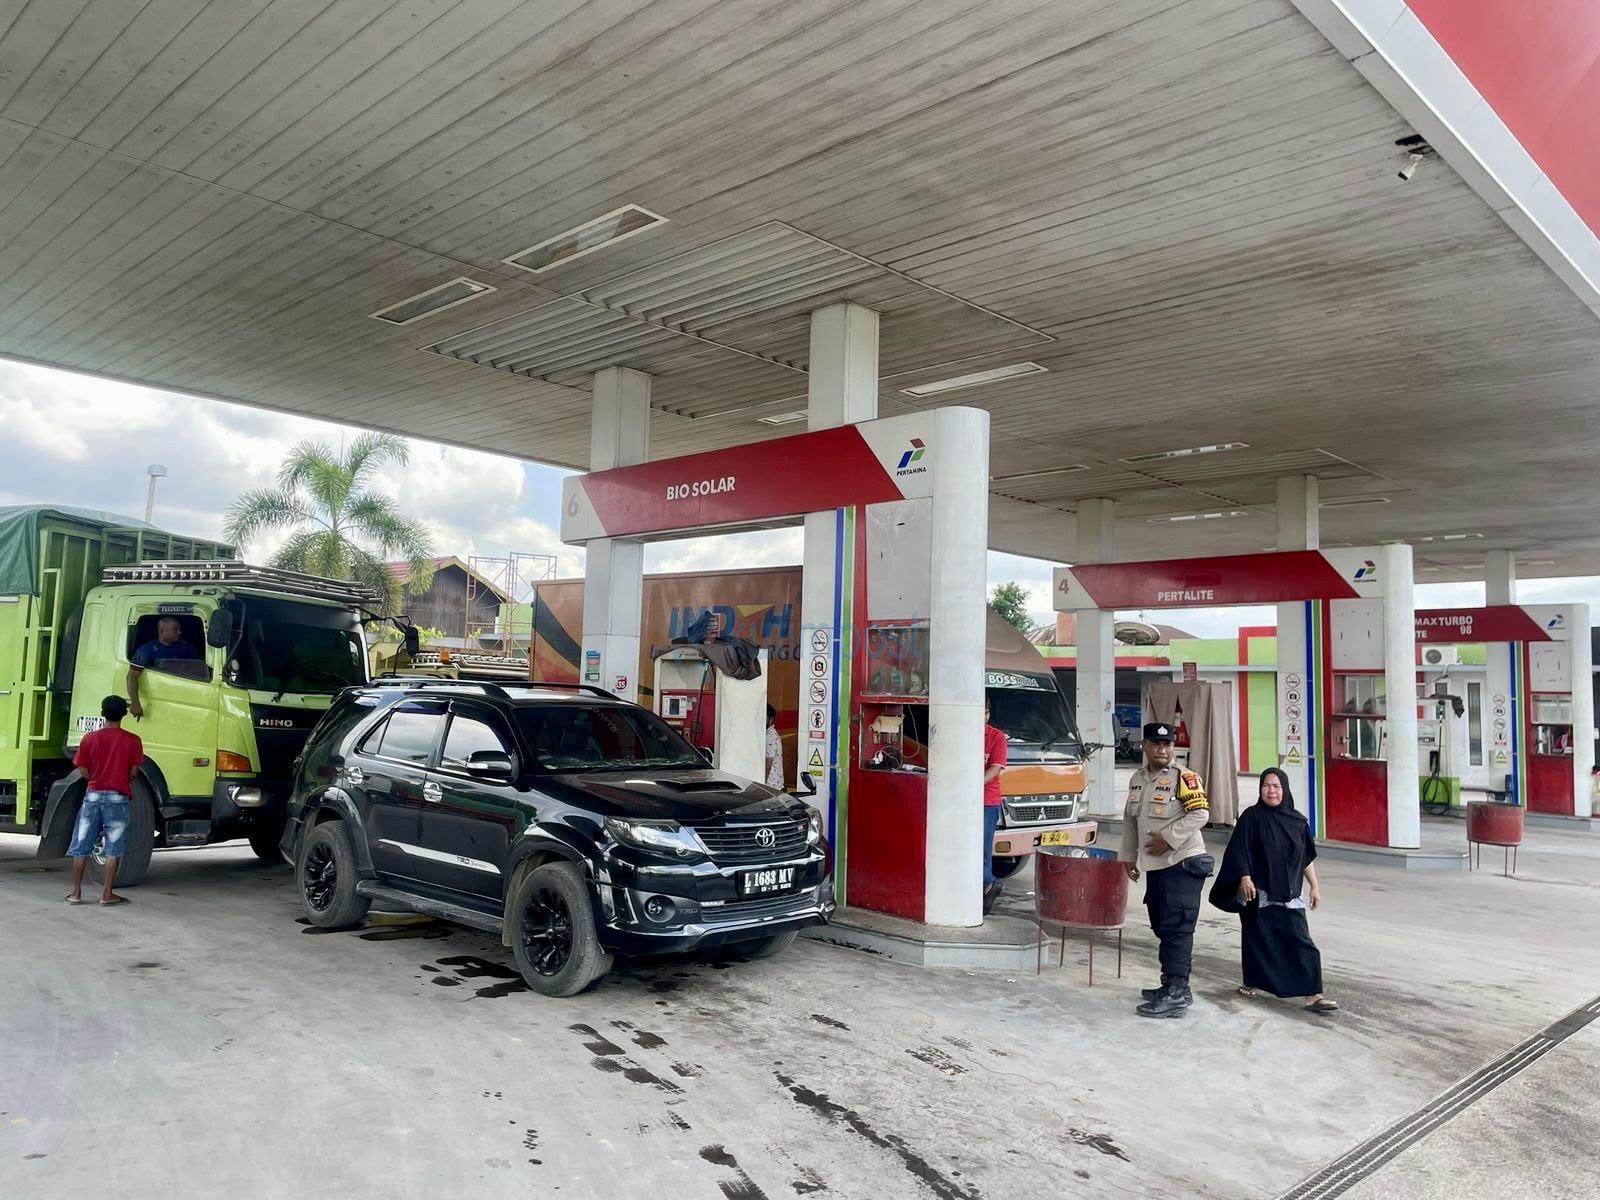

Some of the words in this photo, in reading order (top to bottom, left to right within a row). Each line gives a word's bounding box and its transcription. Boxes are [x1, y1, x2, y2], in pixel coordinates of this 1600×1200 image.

[896, 467, 927, 477] PERTAMINA
[666, 486, 690, 501] BIO
[691, 476, 736, 497] SOLAR
[567, 495, 578, 518] 6
[1058, 578, 1070, 595] 4
[1157, 589, 1214, 602] PERTALITE
[1438, 615, 1473, 627] TURBO
[1459, 625, 1473, 635] 98
[988, 674, 1017, 685] BOSS
[259, 719, 293, 727] HINO
[456, 856, 470, 865] TRD
[744, 872, 752, 888] L
[754, 870, 777, 887] 1683
[778, 867, 794, 883] MV
